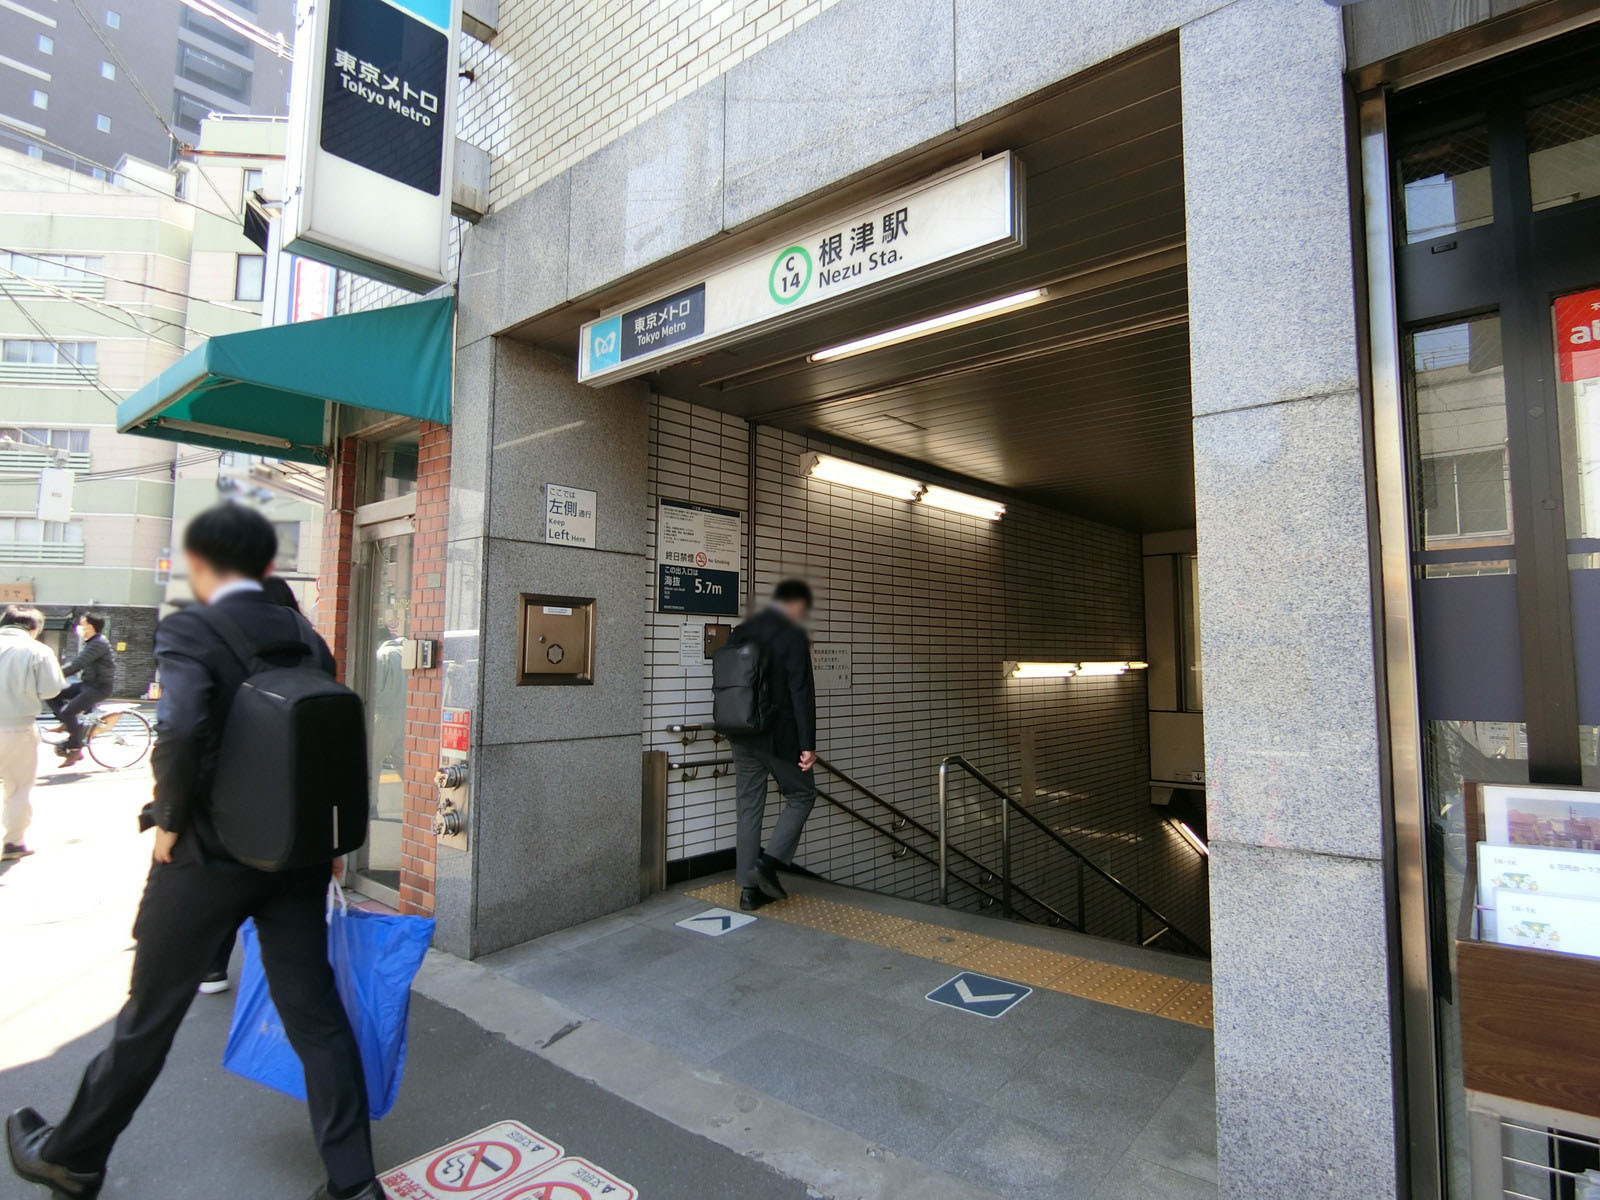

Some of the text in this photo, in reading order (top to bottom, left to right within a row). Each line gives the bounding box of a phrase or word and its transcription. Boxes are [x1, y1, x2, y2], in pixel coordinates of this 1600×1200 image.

[334, 48, 438, 114] 東京メトロ
[340, 72, 431, 127] Tokyo Metro
[818, 207, 909, 268] 根津駅
[785, 256, 795, 272] C
[818, 249, 903, 289] Nezu Sta.
[782, 272, 801, 293] 14
[634, 299, 690, 334] 東京メトロ
[637, 321, 687, 347] Tokyo Metro
[550, 488, 576, 499] ここでは
[549, 498, 578, 518] 左側
[549, 517, 566, 527] Keep
[549, 528, 587, 543] Left Here
[665, 551, 695, 563] 終日禁煙
[664, 566, 699, 576] この出入口は
[664, 575, 681, 587] 海抜
[694, 578, 723, 595] 5.7m
